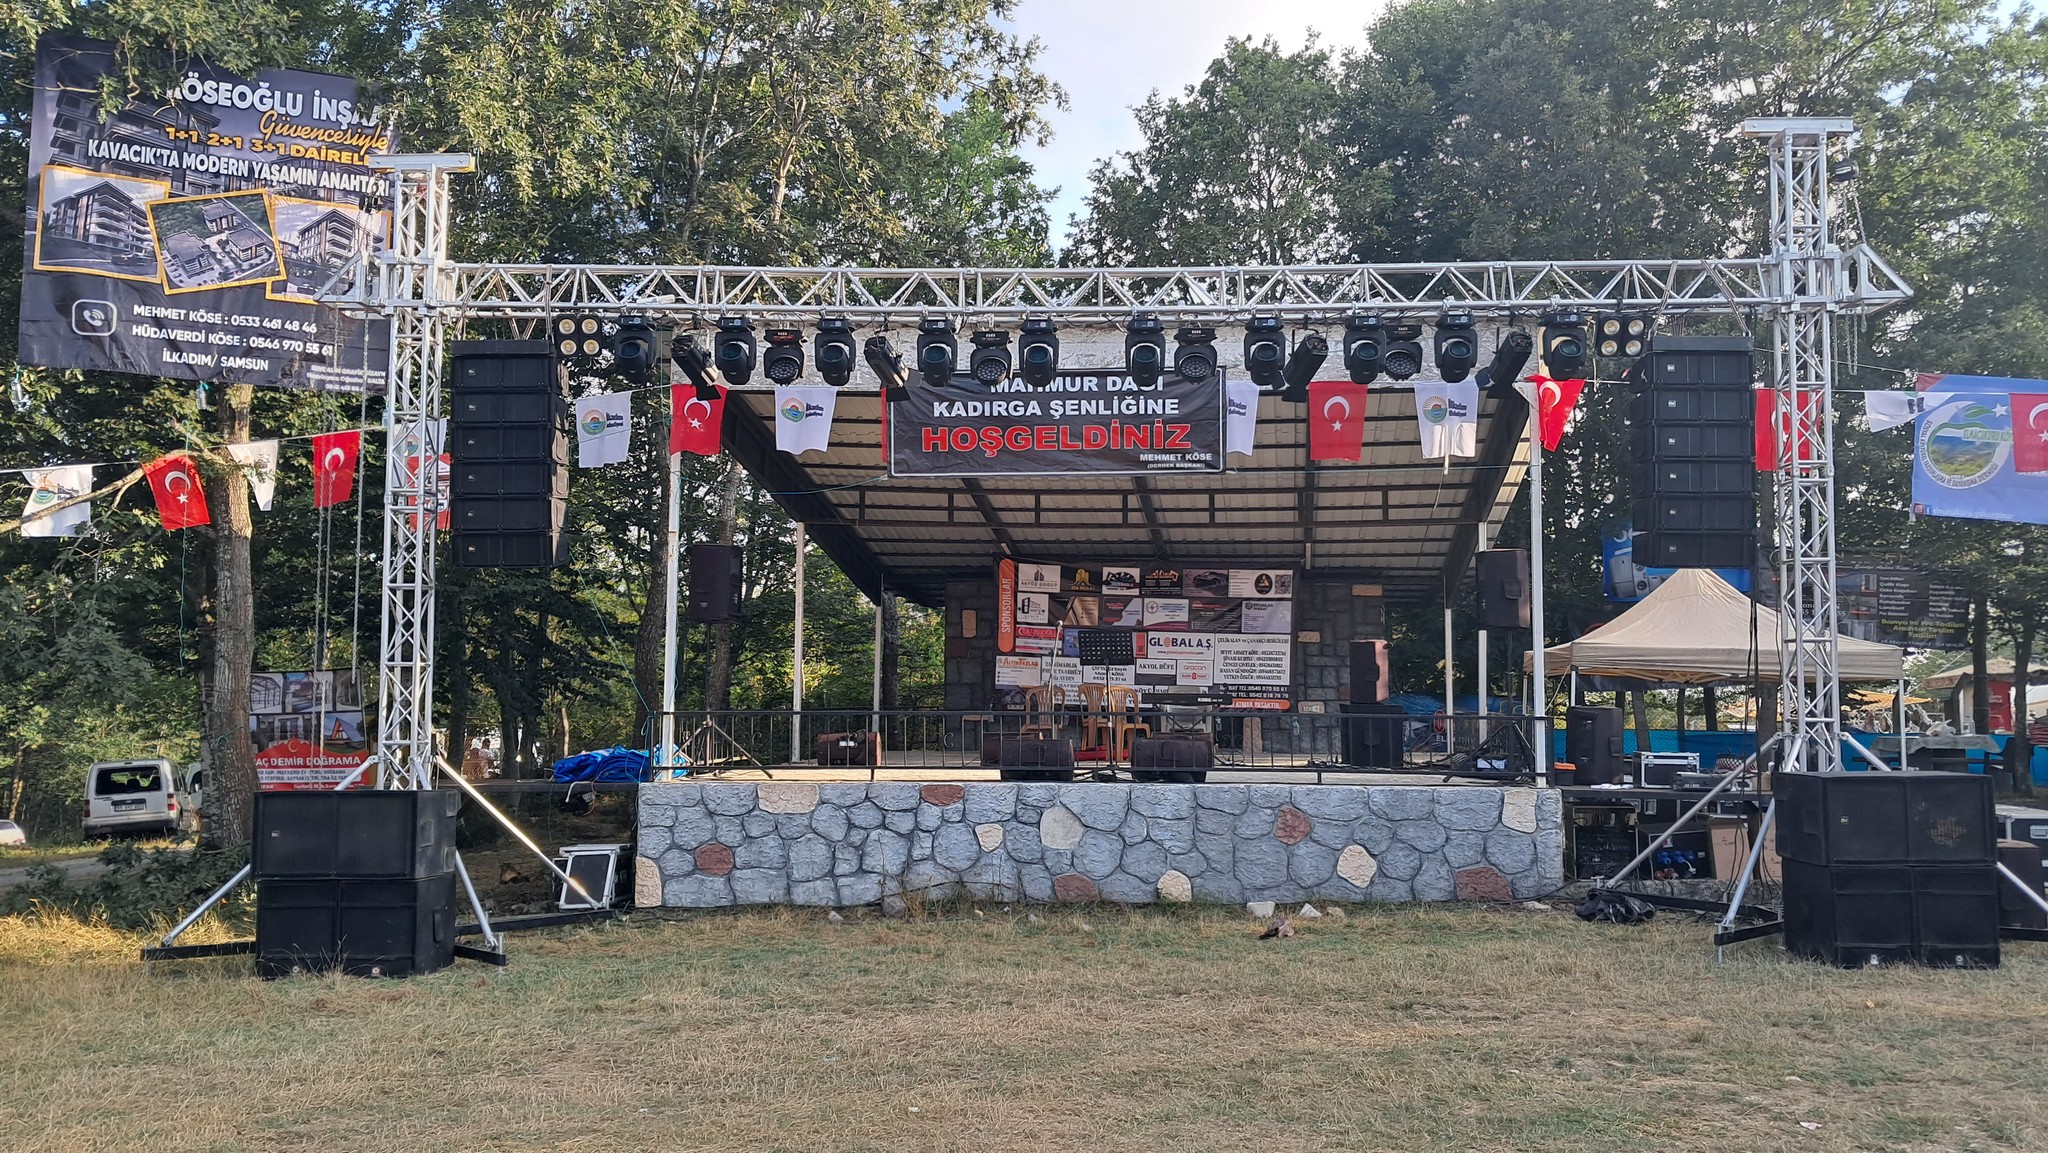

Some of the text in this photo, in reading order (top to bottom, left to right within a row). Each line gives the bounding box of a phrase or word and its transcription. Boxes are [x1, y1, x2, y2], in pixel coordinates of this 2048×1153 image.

[165, 126, 199, 143] 1+1
[207, 133, 243, 150] 2+1
[251, 138, 286, 155] 3+1
[182, 154, 249, 178] MODERN
[253, 160, 320, 187] YAŞAMIN
[133, 304, 187, 321] MEHMET
[188, 308, 222, 326] KÖSE
[231, 314, 260, 328] 0533
[262, 318, 282, 330] 461
[284, 320, 300, 332] 48
[301, 322, 318, 335] 46
[132, 324, 206, 344] HÜDAVERDİ
[208, 330, 241, 347] KÖSE
[249, 337, 281, 351] 0546
[282, 340, 304, 353] 970
[305, 343, 320, 355] 55
[321, 345, 335, 357] 61
[162, 347, 269, 372] İLKADIM/ SAMSUN
[933, 395, 1180, 420] KADIRGA ŞENLİĞİNE
[921, 418, 1192, 458] HOŞGELDİNİZ
[1139, 451, 1213, 462] MEHMET KÖSE
[1001, 577, 1011, 633] SPONSORLAR
[1159, 663, 1174, 671] BÜFE
[255, 754, 361, 768] AÇ DEMİR DOĞRAMA
